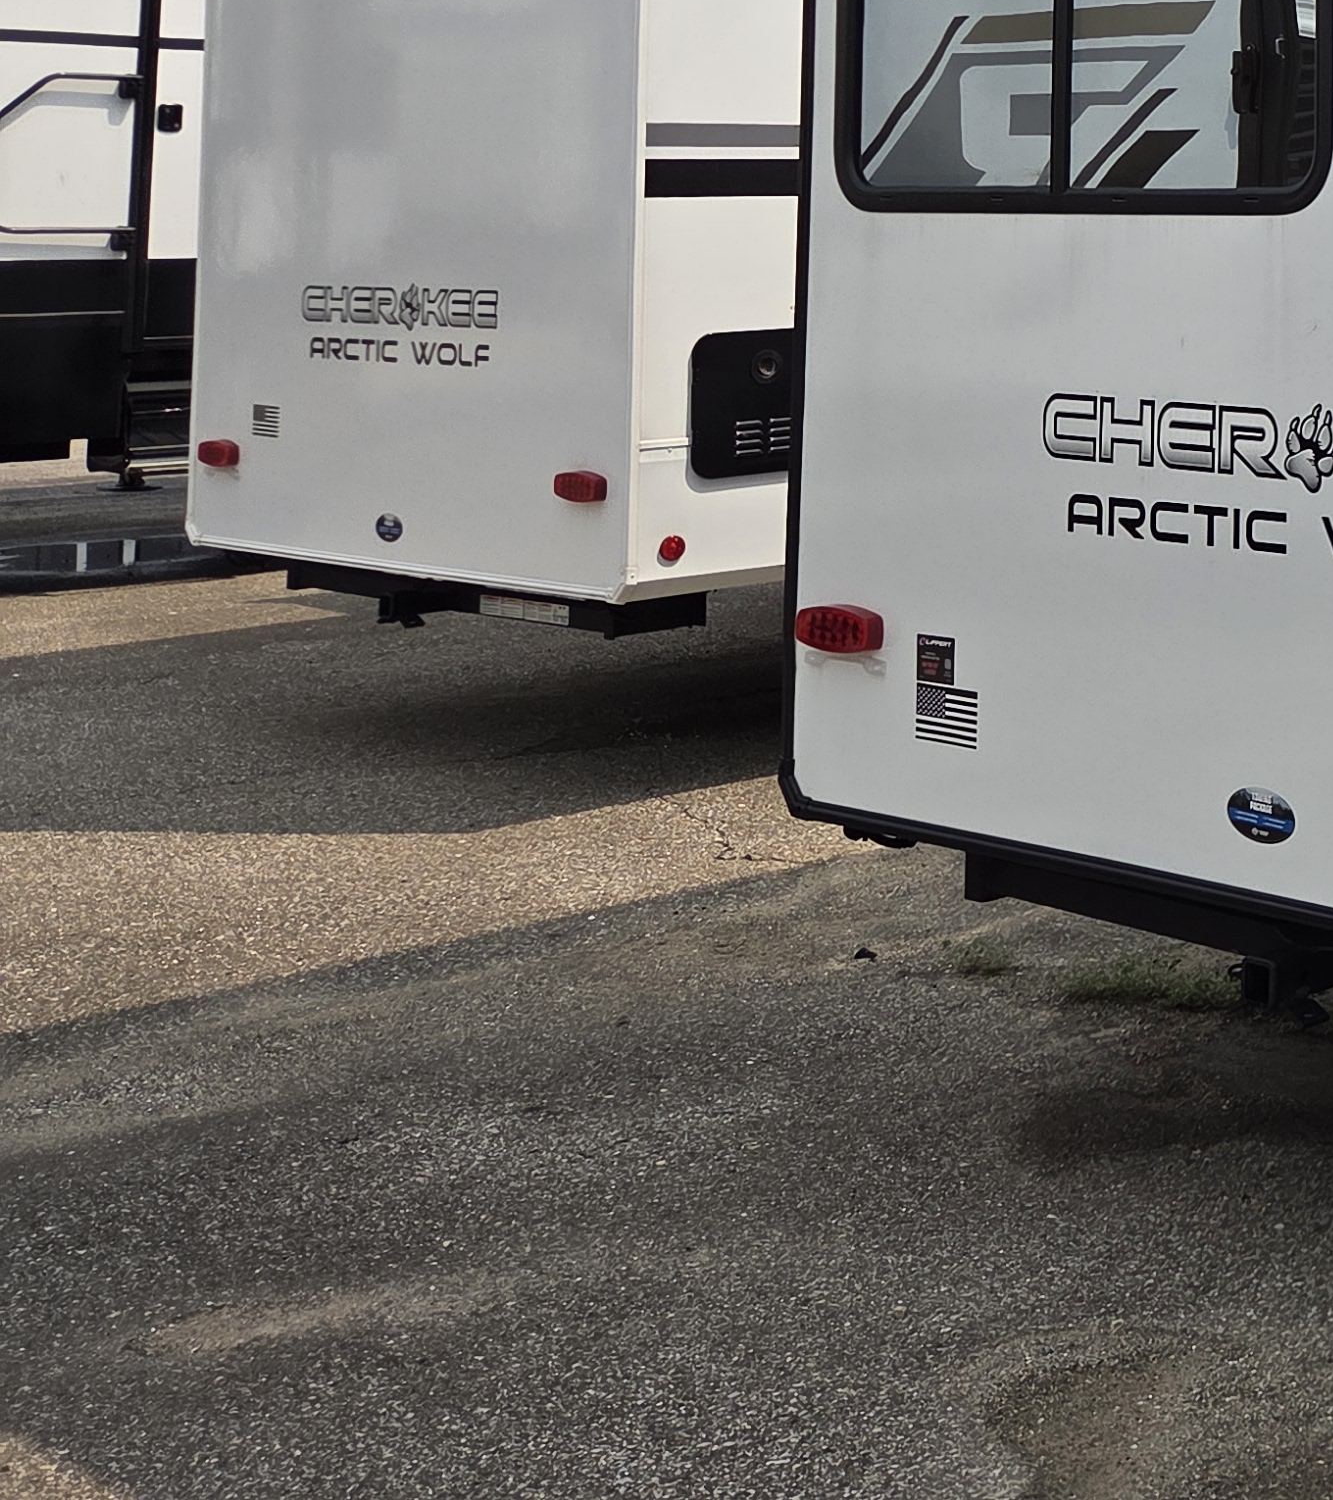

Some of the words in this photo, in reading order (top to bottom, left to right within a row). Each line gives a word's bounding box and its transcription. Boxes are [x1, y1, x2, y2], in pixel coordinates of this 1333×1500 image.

[309, 337, 398, 363] ARCTIC
[411, 341, 490, 367] WOLF
[1067, 493, 1288, 555] ARCTIC
